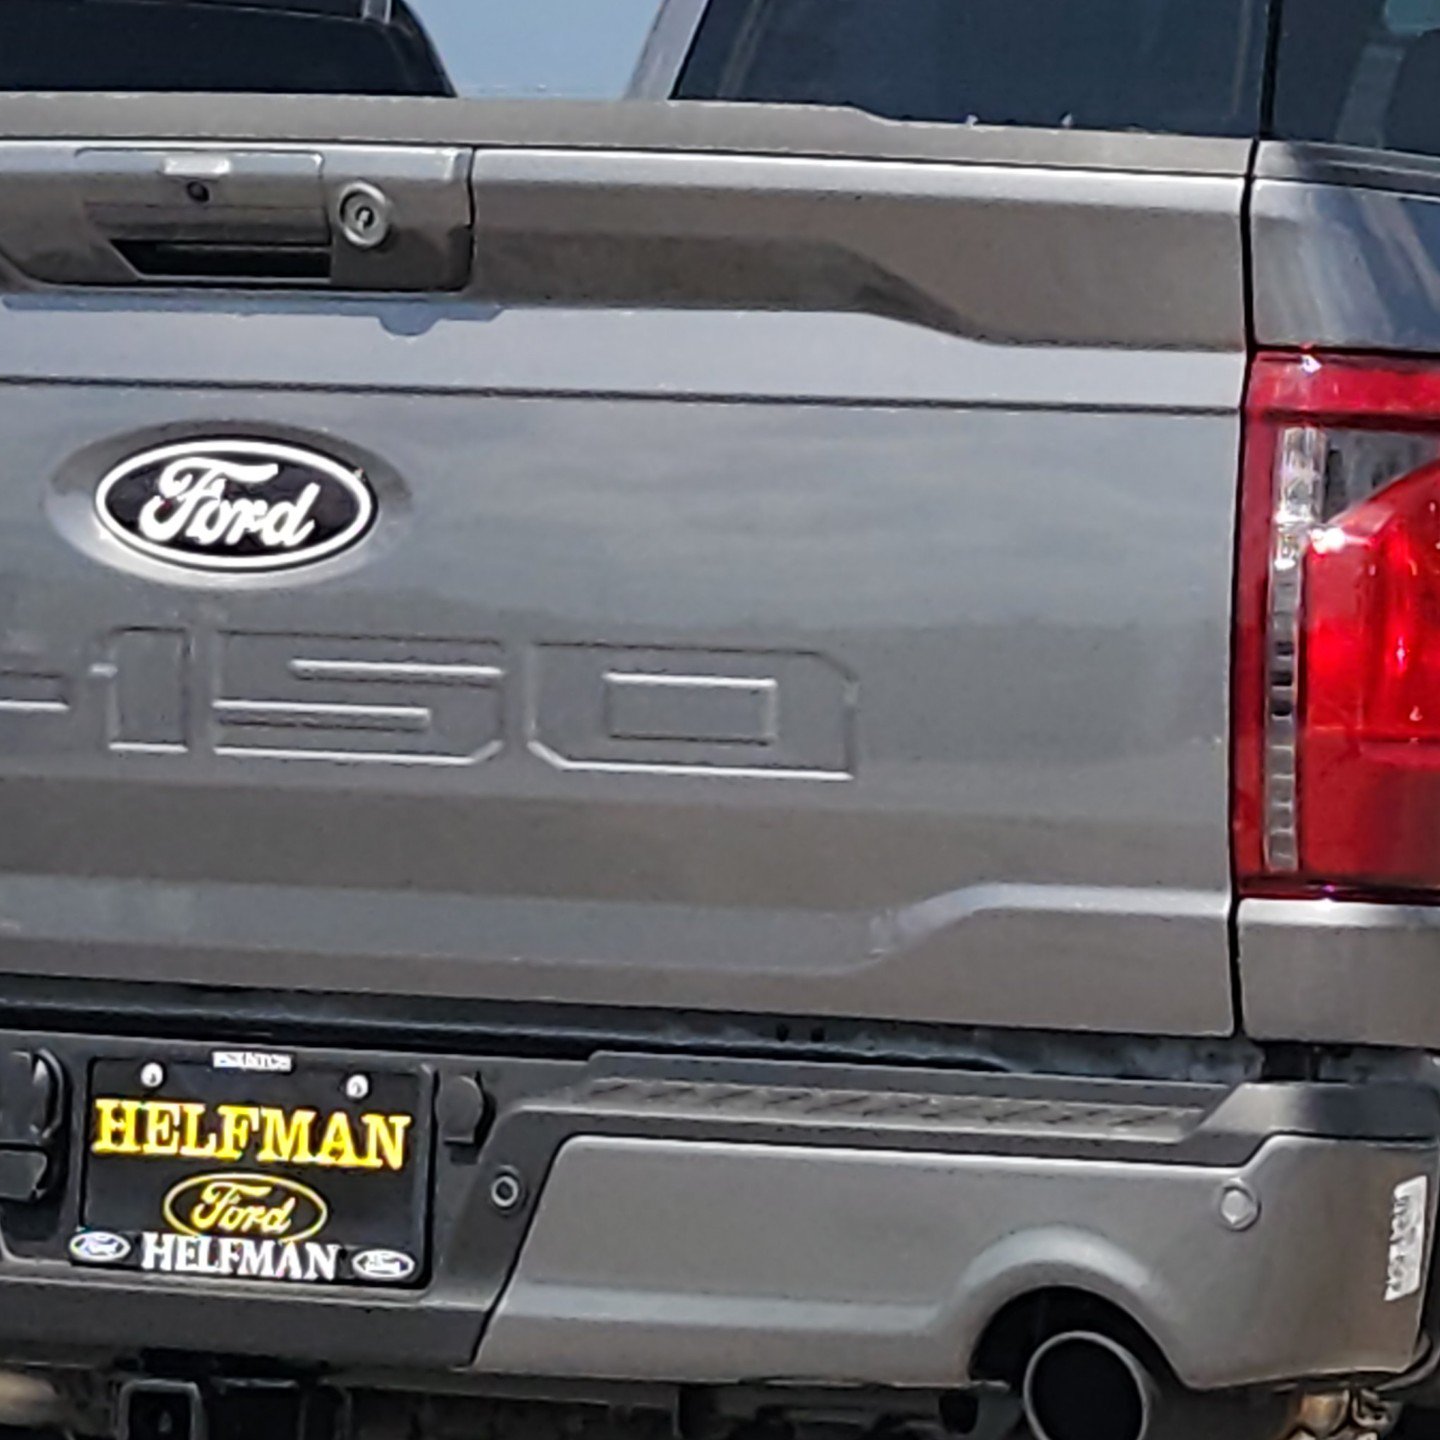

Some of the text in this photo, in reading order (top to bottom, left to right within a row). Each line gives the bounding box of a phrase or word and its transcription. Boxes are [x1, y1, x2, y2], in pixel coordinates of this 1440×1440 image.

[138, 455, 322, 547] Ford
[91, 1098, 411, 1170] HELFMAN
[189, 1180, 296, 1233] Ford
[139, 1231, 343, 1281] HELFMAN
